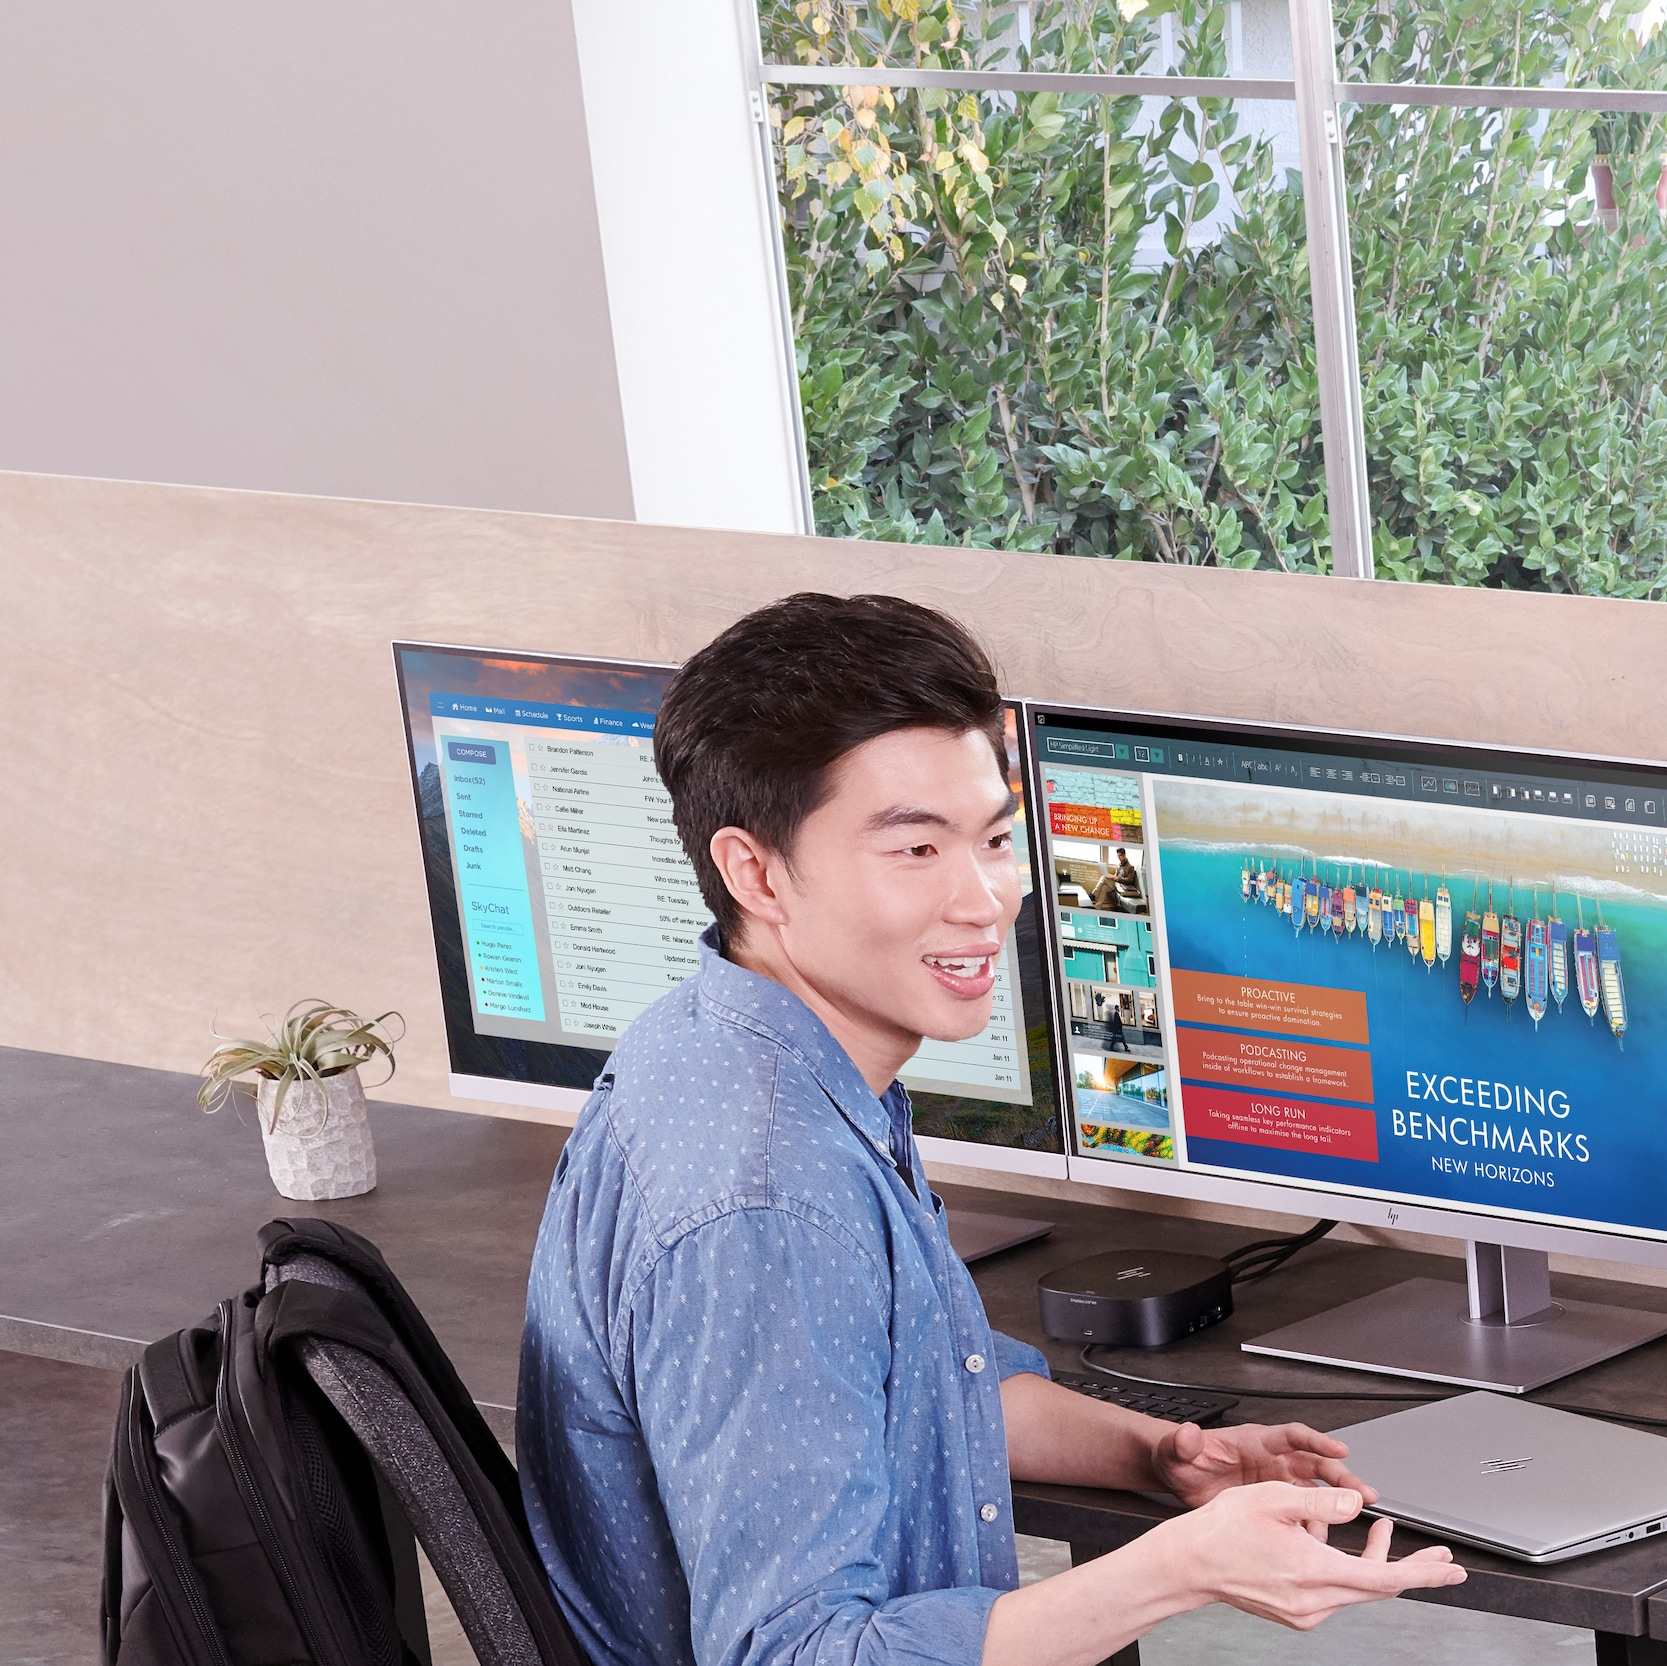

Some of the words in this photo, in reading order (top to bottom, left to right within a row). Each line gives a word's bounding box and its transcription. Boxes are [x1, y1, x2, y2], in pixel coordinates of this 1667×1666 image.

[459, 704, 477, 713] Home
[493, 707, 505, 715] Mail
[521, 710, 549, 721] Schedule
[563, 714, 583, 723] Sports
[599, 718, 623, 727] Finance
[456, 748, 487, 758] COMPOSE
[454, 775, 486, 786] Inbox(52)
[456, 792, 472, 801] Sent
[459, 810, 483, 819] Starred
[1053, 813, 1087, 824] BRINGING
[1089, 817, 1098, 825] UP
[461, 827, 487, 837] Deleted
[1055, 823, 1060, 831] A
[1062, 824, 1078, 832] NEW
[1080, 826, 1110, 836] CHANGE
[463, 844, 483, 853] Drafts
[466, 862, 481, 870] Junk
[471, 901, 510, 915] SkyChat
[570, 924, 587, 932] Emma
[588, 926, 603, 934] Smith
[1240, 987, 1296, 1003] PROACTIVE
[1197, 994, 1216, 1005] Bring
[1223, 997, 1235, 1006] the
[1237, 999, 1254, 1009] table
[1254, 1001, 1282, 1011] win-win
[1283, 1007, 1309, 1015] survival
[1311, 1009, 1343, 1021] strategies
[1251, 1013, 1281, 1022] proactive
[1283, 1014, 1322, 1026] domination.
[1240, 1044, 1307, 1062] PODCASTING
[1202, 1051, 1238, 1065] Podcasting
[1239, 1058, 1277, 1068] operational
[1279, 1062, 1303, 1073] change
[1305, 1067, 1347, 1077] management
[1202, 1062, 1222, 1072] inside
[1222, 1064, 1232, 1072] of
[1232, 1065, 1265, 1076] workflows
[1266, 1070, 1274, 1078] to
[1275, 1072, 1304, 1081] establish
[1312, 1075, 1349, 1088] framework.
[1406, 1071, 1570, 1119] EXCEEDING
[1251, 1103, 1281, 1118] LONG
[1284, 1107, 1306, 1119] RUN
[1209, 1109, 1232, 1121] Taking
[1232, 1114, 1261, 1124] seamless
[1262, 1117, 1274, 1127] key
[1275, 1119, 1317, 1131] performance
[1318, 1125, 1351, 1136] indicators
[1228, 1121, 1248, 1131] offline
[1257, 1128, 1289, 1137] maximise
[1291, 1130, 1302, 1139] the
[1303, 1132, 1320, 1143] long
[1320, 1135, 1333, 1143] tail.
[1392, 1109, 1589, 1162] BENCHMARKS
[1432, 1156, 1468, 1174] NEW
[1474, 1162, 1554, 1187] HORIZONS
